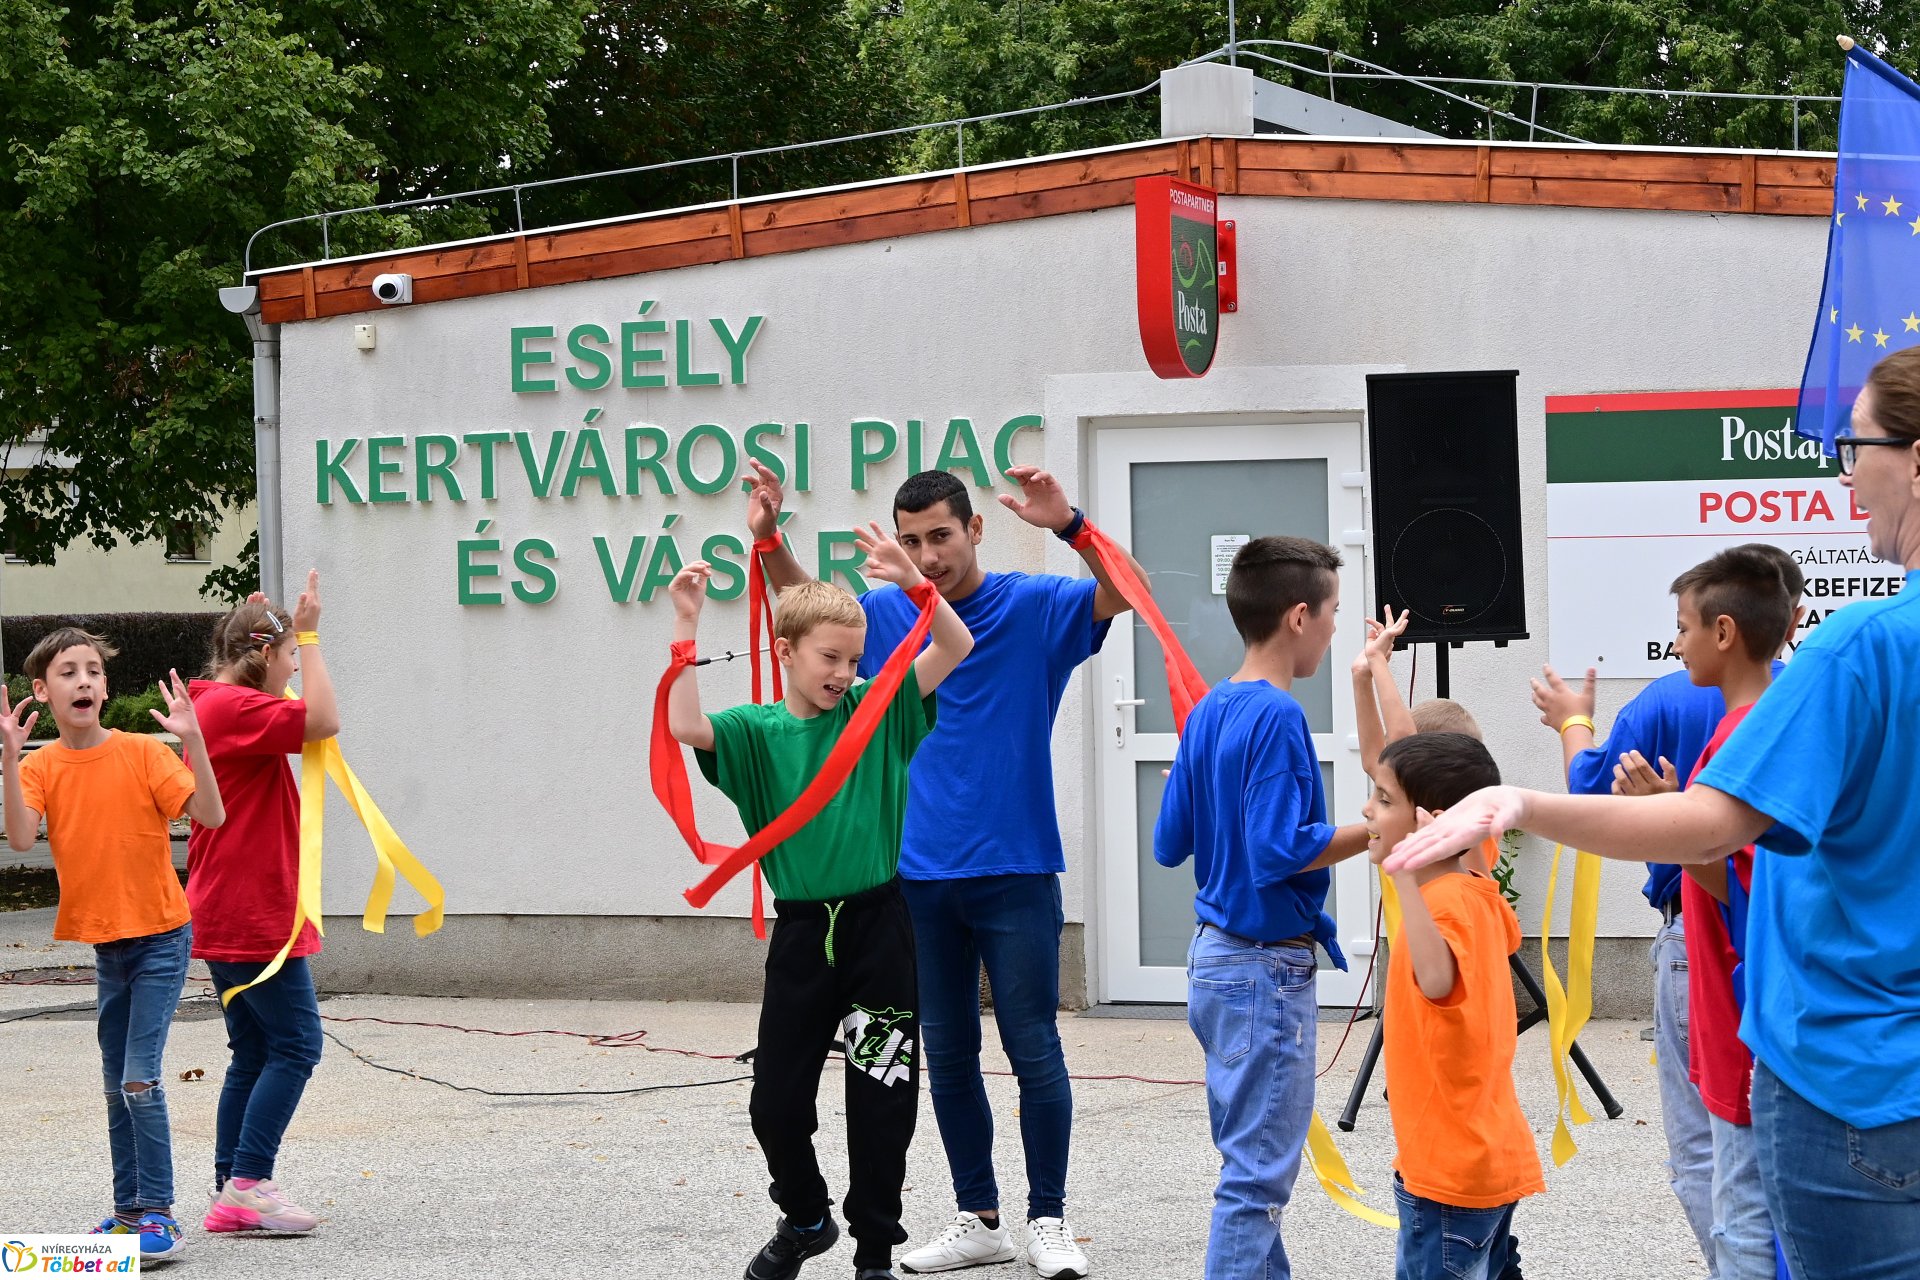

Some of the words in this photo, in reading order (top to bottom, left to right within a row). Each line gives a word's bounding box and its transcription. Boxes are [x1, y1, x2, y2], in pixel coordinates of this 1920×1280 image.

[1169, 188, 1215, 214] POSTAPARTNER
[1177, 290, 1208, 335] Posta
[511, 300, 766, 394] ESÉLY
[316, 408, 811, 504] KERTVÁROSI
[850, 414, 1045, 491] PIAC
[1700, 490, 1835, 523] POSTA
[458, 519, 559, 606] ÉS
